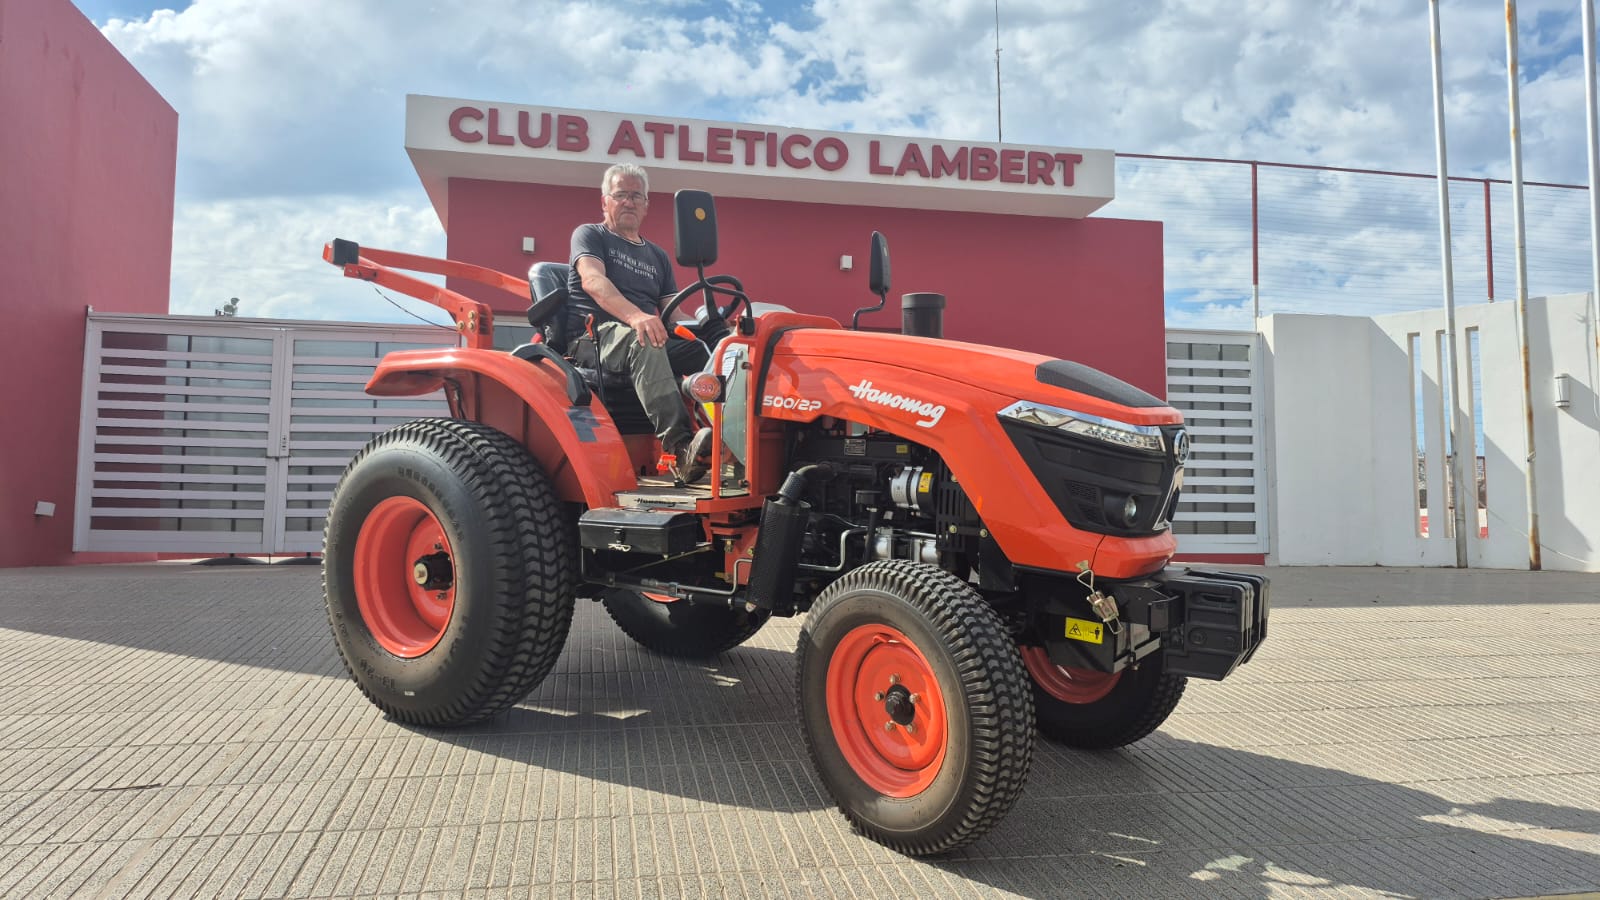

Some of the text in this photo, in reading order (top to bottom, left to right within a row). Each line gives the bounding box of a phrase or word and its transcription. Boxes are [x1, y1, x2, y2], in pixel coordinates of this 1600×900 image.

[449, 106, 1083, 187] CLUB ATLETICO LAMBERT
[762, 395, 822, 411] 500/2P
[849, 379, 946, 428] Hanomag
